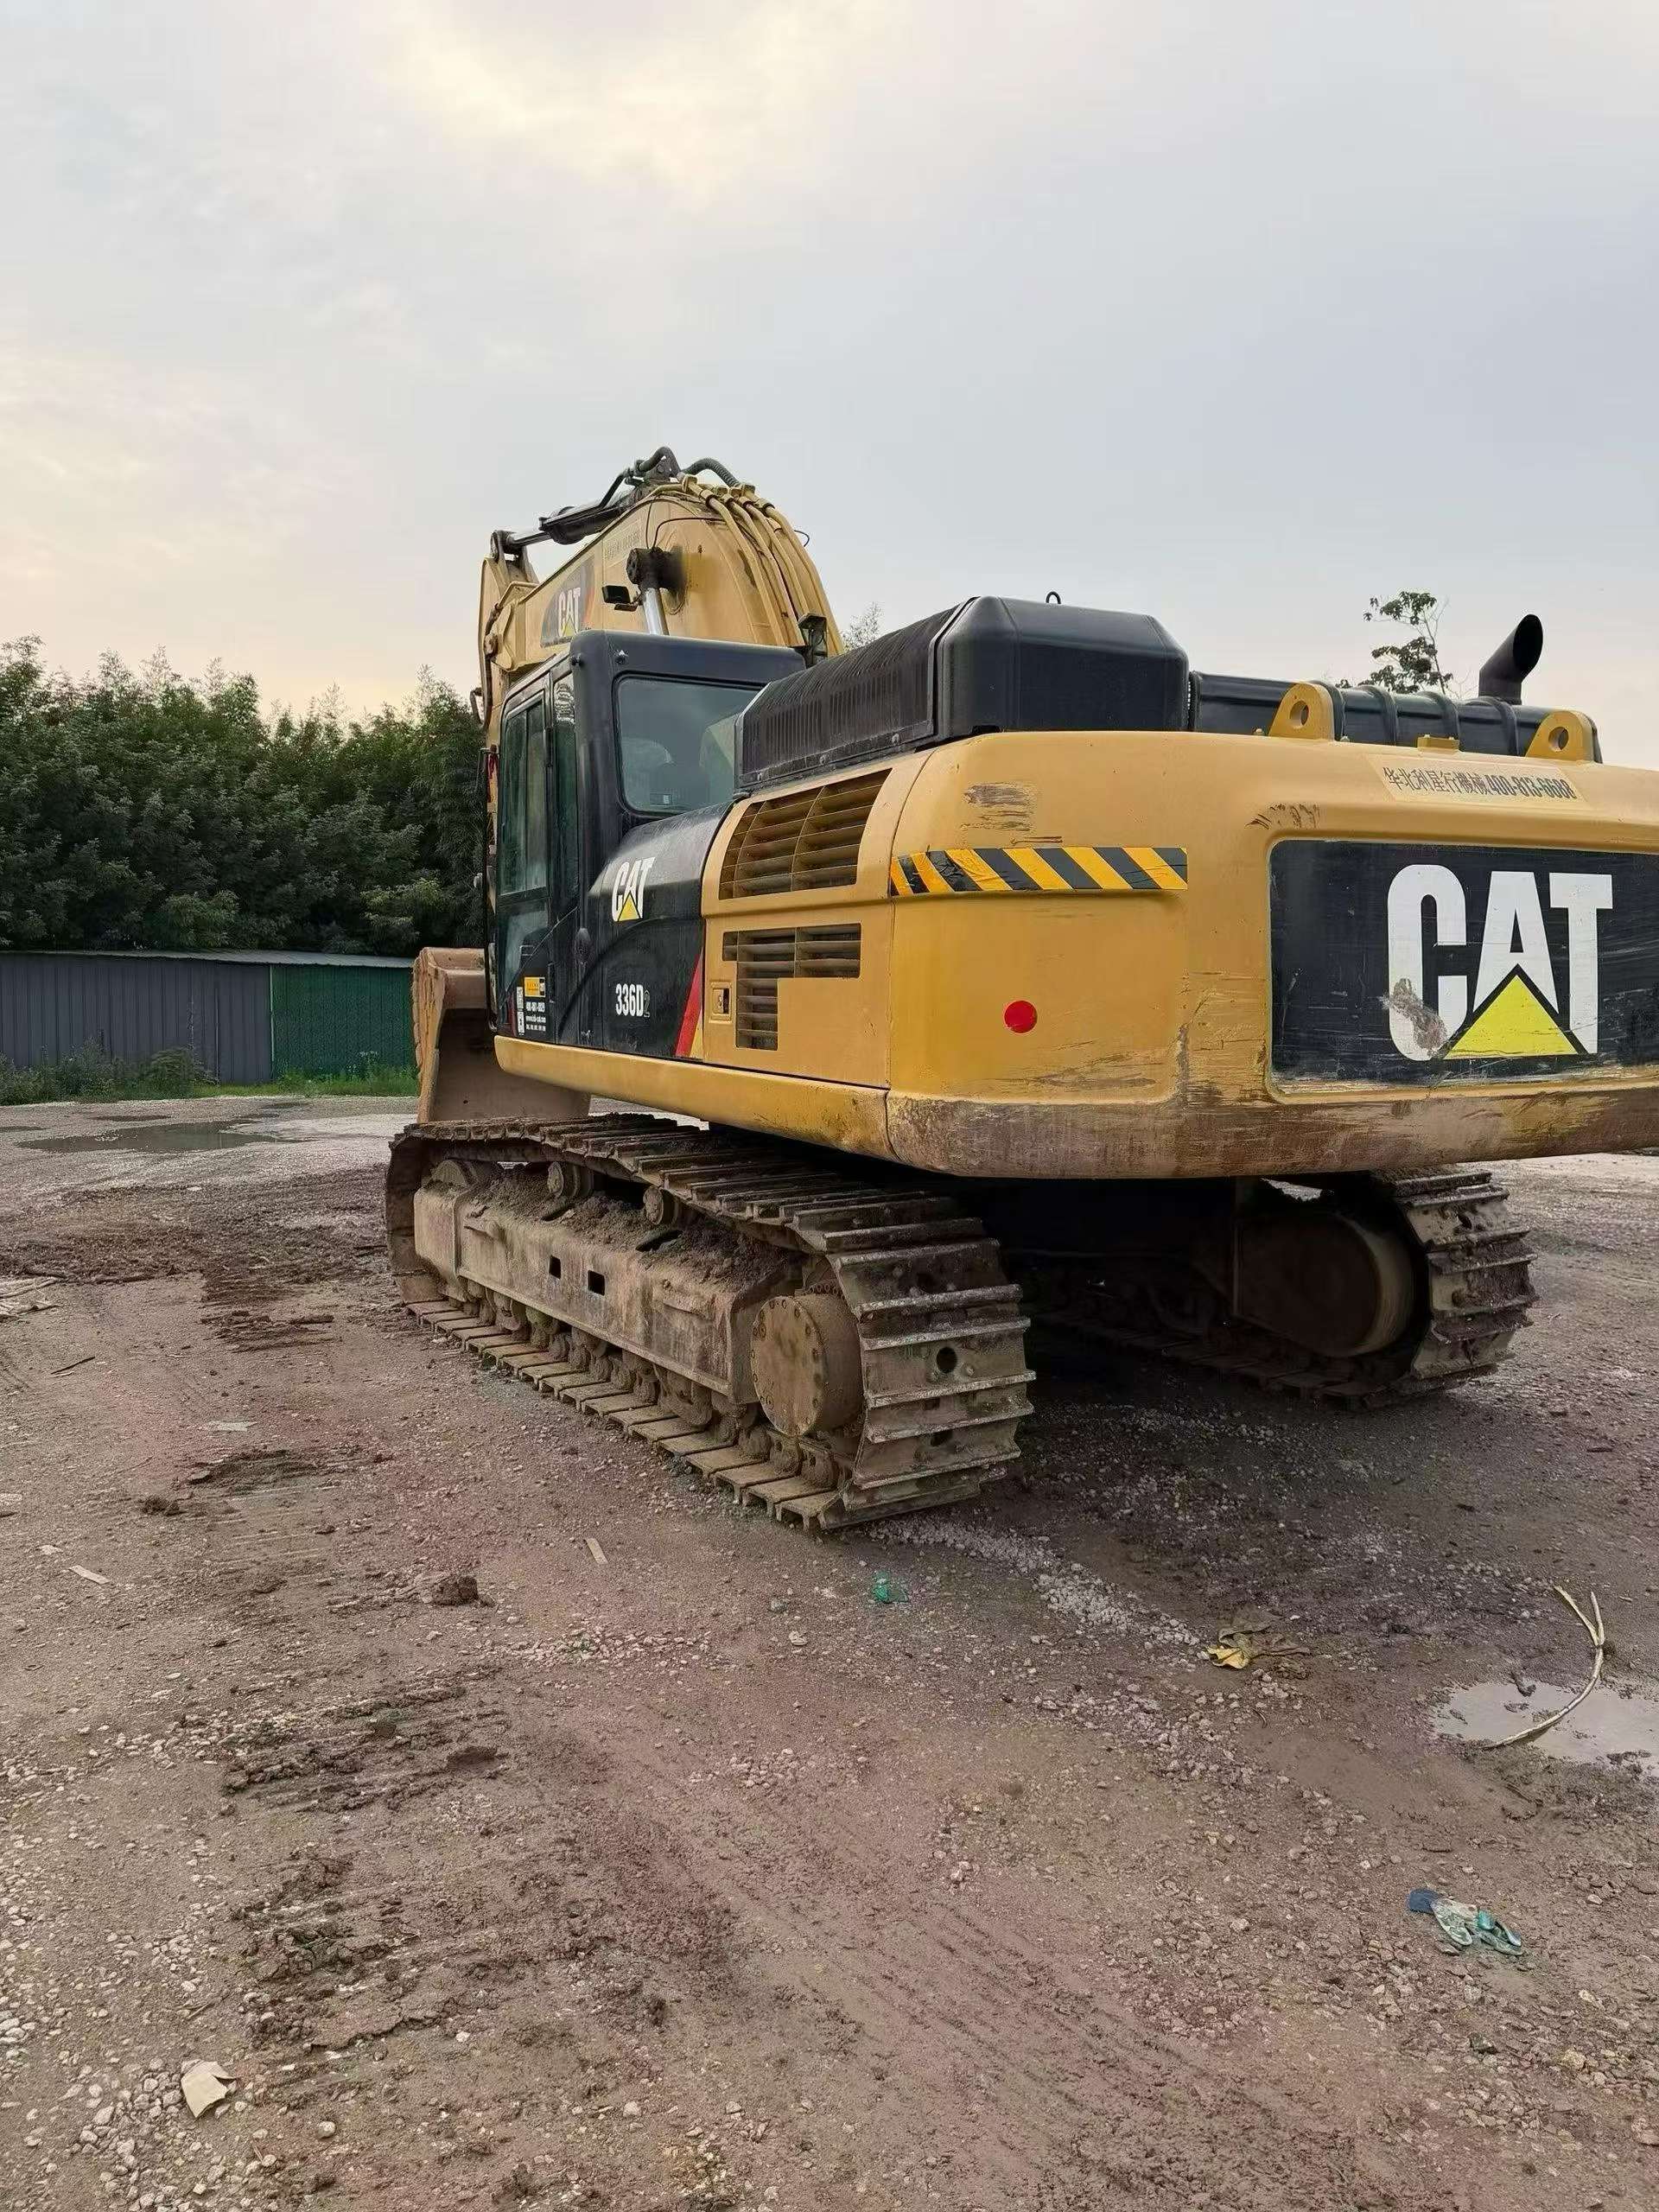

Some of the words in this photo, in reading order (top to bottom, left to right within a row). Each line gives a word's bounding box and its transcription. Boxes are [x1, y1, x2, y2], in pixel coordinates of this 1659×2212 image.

[557, 588, 582, 638] CAT
[611, 856, 656, 922] CAT
[1387, 864, 1613, 1061] CAT
